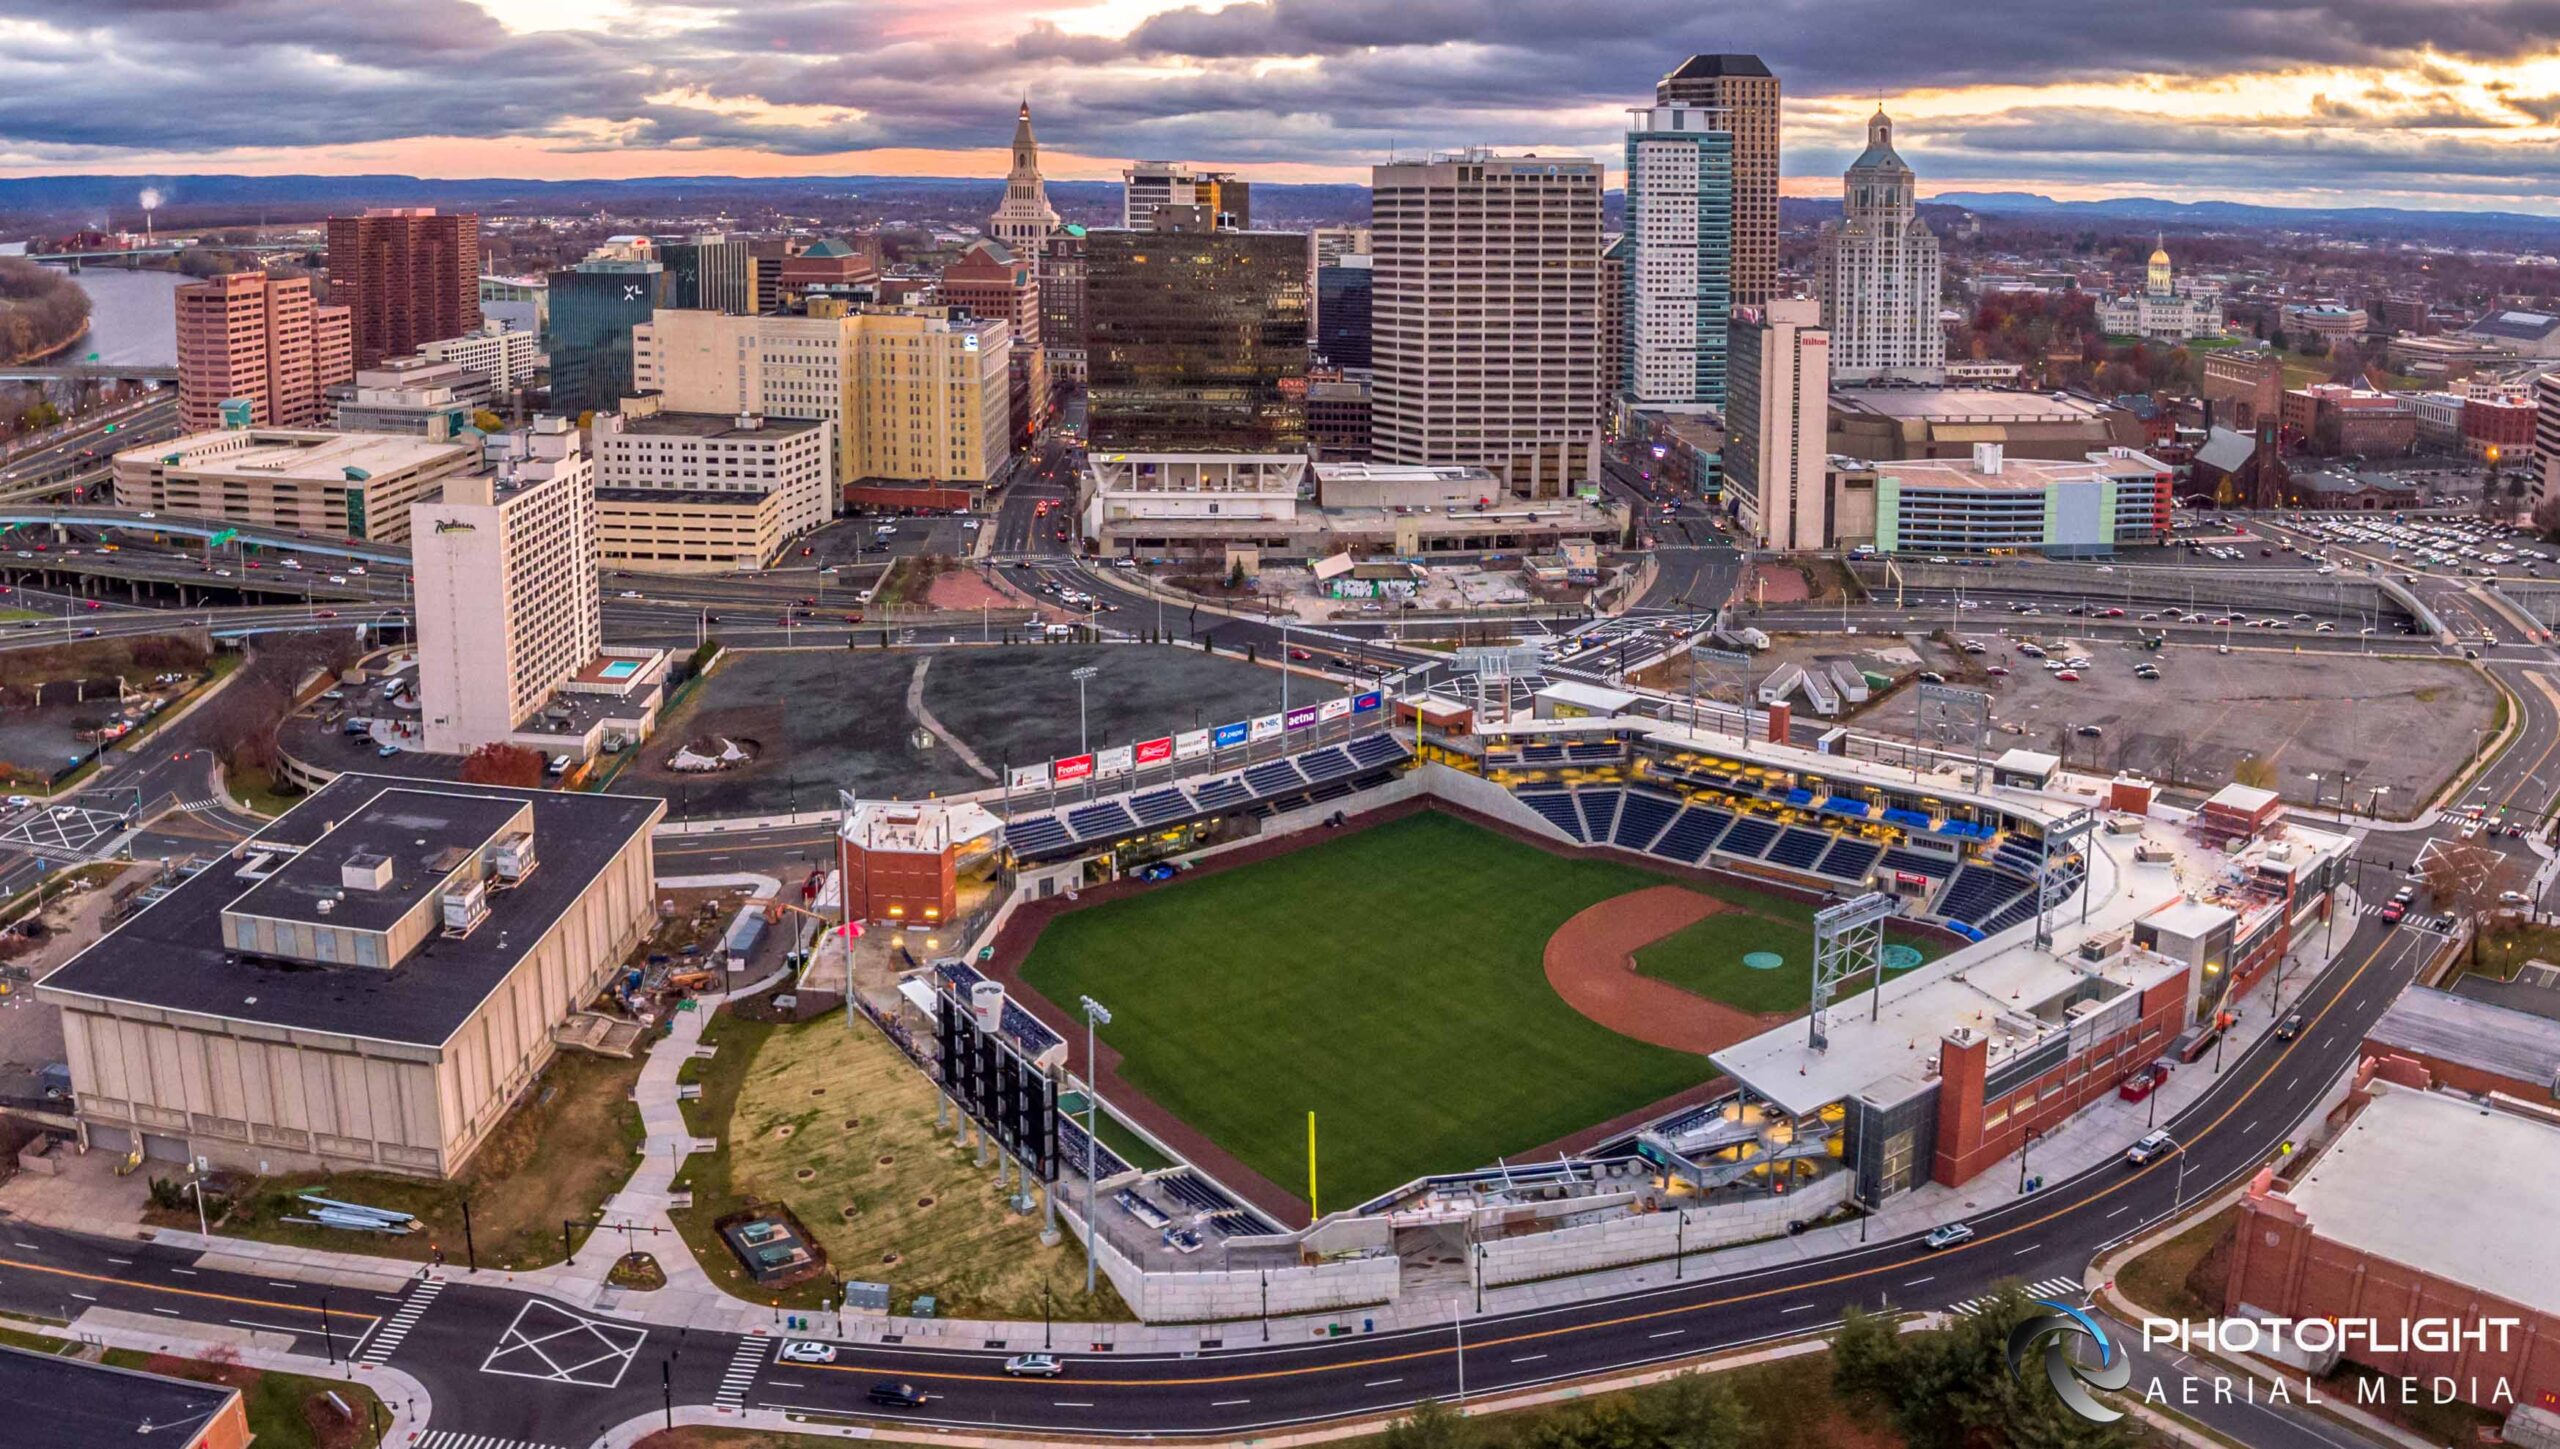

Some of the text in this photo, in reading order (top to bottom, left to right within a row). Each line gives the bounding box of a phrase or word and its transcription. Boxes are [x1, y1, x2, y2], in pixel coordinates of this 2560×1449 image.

[624, 285, 643, 301] XL
[1802, 337, 1827, 346] Hilton
[1288, 712, 1315, 726] aetna
[1057, 763, 1089, 775] Frontier
